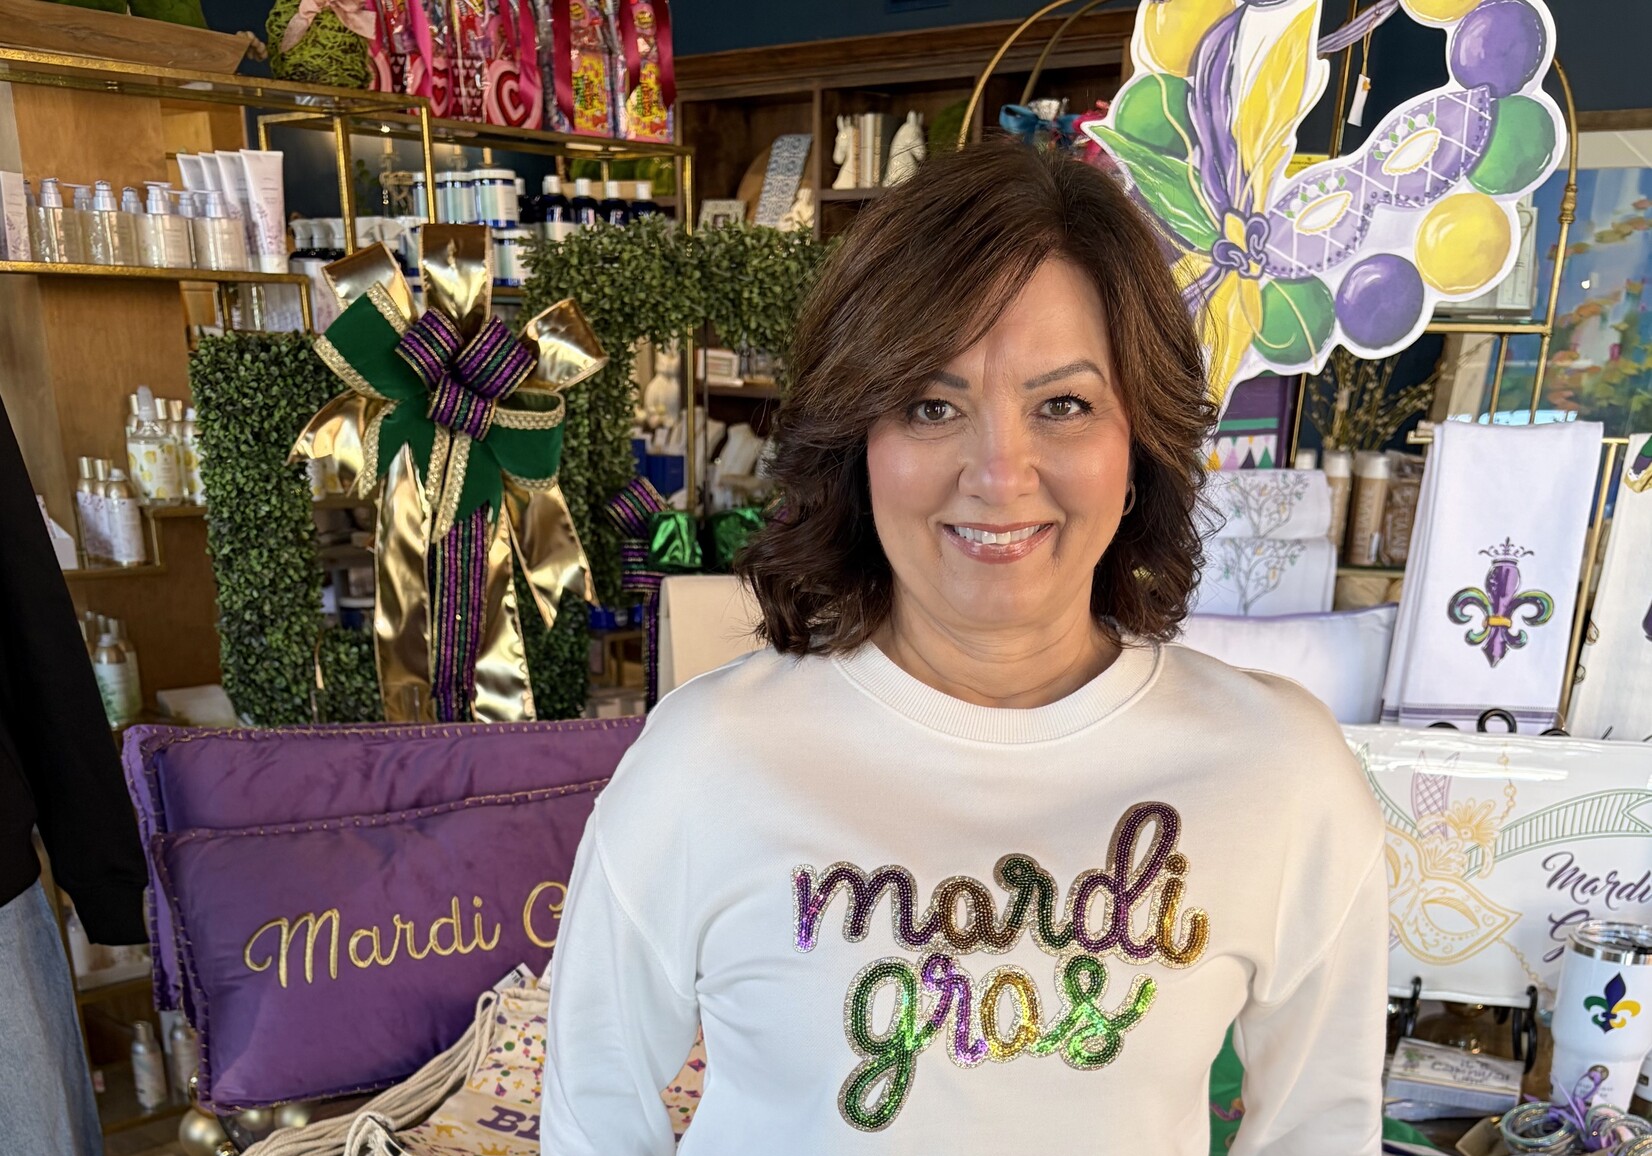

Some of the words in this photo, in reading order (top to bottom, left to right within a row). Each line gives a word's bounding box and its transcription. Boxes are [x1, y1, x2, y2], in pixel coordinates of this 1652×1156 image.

[243, 896, 500, 987] Mardi
[791, 801, 1211, 969] mardi
[1541, 851, 1652, 911] Mardi
[837, 951, 1158, 1132] gras
